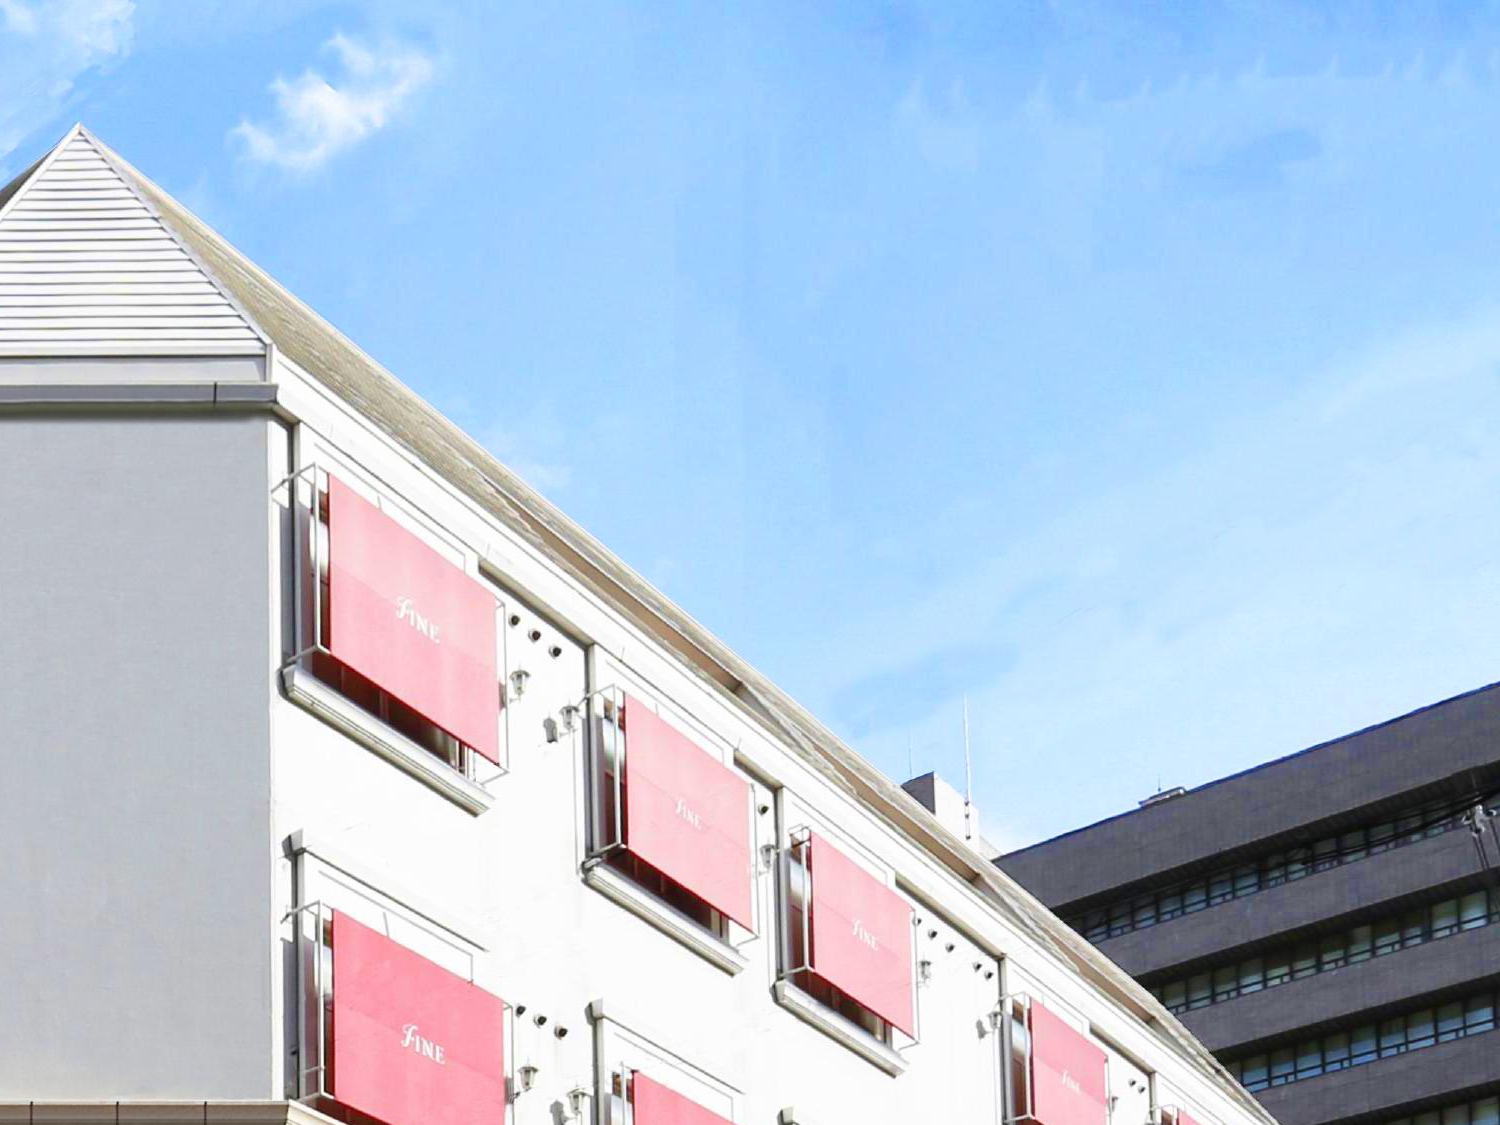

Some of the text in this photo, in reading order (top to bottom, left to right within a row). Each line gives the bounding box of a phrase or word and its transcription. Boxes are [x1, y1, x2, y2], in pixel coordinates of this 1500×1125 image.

[396, 596, 440, 643] FINE
[852, 919, 877, 950] FINE
[401, 1024, 444, 1064] FINE
